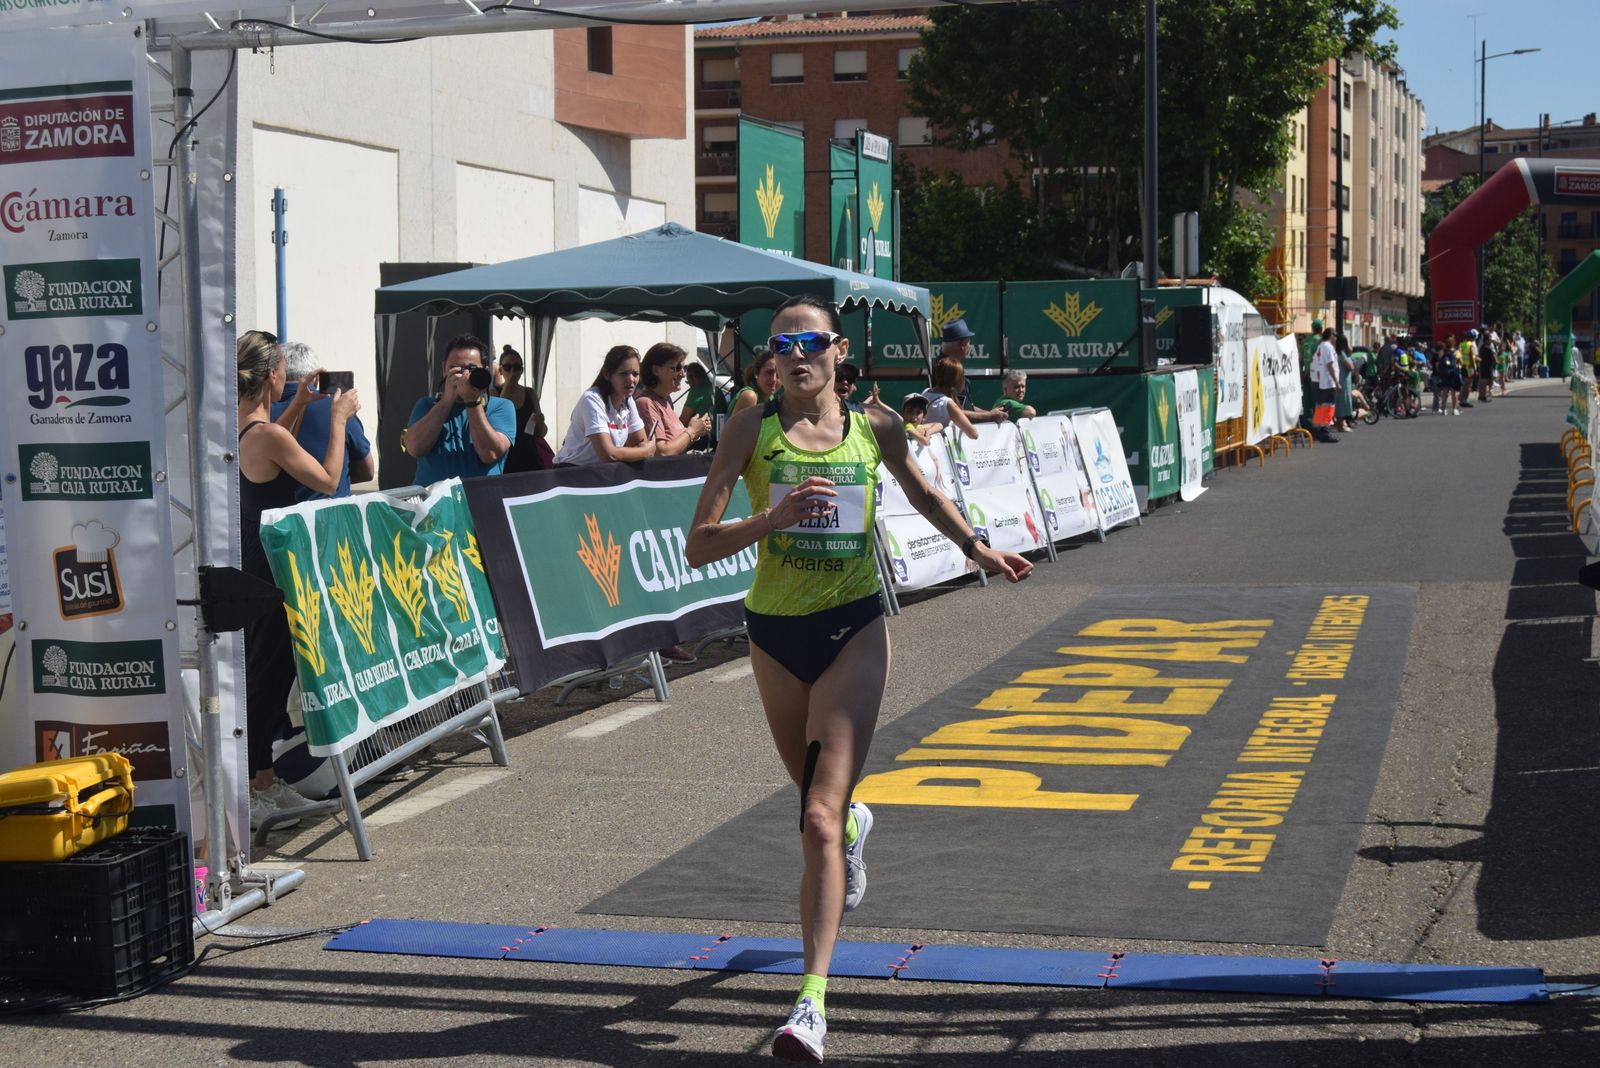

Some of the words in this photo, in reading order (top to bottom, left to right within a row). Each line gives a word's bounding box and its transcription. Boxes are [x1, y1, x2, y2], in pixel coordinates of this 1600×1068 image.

[24, 108, 101, 127] DIPUTACIÓN
[104, 108, 125, 121] DE
[24, 124, 127, 150] ZAMORA
[48, 230, 88, 242] Zamora
[48, 280, 133, 297] FUNDACION
[49, 299, 77, 311] CAJA
[79, 295, 133, 310] RURAL
[882, 344, 924, 359] CAJA
[1019, 343, 1062, 359] CAJA
[1067, 342, 1129, 358] RURAL
[24, 343, 130, 410] gaza
[30, 413, 74, 425] Ganaderos
[75, 413, 86, 424] de
[87, 412, 132, 424] Zamora
[60, 465, 143, 480] FUNDACION
[800, 466, 856, 475] FUNDACION
[60, 480, 86, 495] CAJA
[89, 480, 144, 494] RURAL
[1095, 480, 1134, 515] OCEANIC
[796, 540, 821, 550] CAJA
[825, 540, 860, 550] RURAL
[629, 527, 703, 592] CAJA
[781, 555, 845, 572] Adarsa
[61, 563, 112, 602] Susi
[69, 661, 155, 676] FUNDACION
[1285, 643, 1355, 679] DISEÑO
[70, 675, 97, 690] CAJA
[100, 675, 156, 690] RURAL
[851, 618, 1274, 811] PIDEPAR
[1236, 694, 1337, 763] INTEGRAL
[1170, 771, 1306, 872] REFORMA
